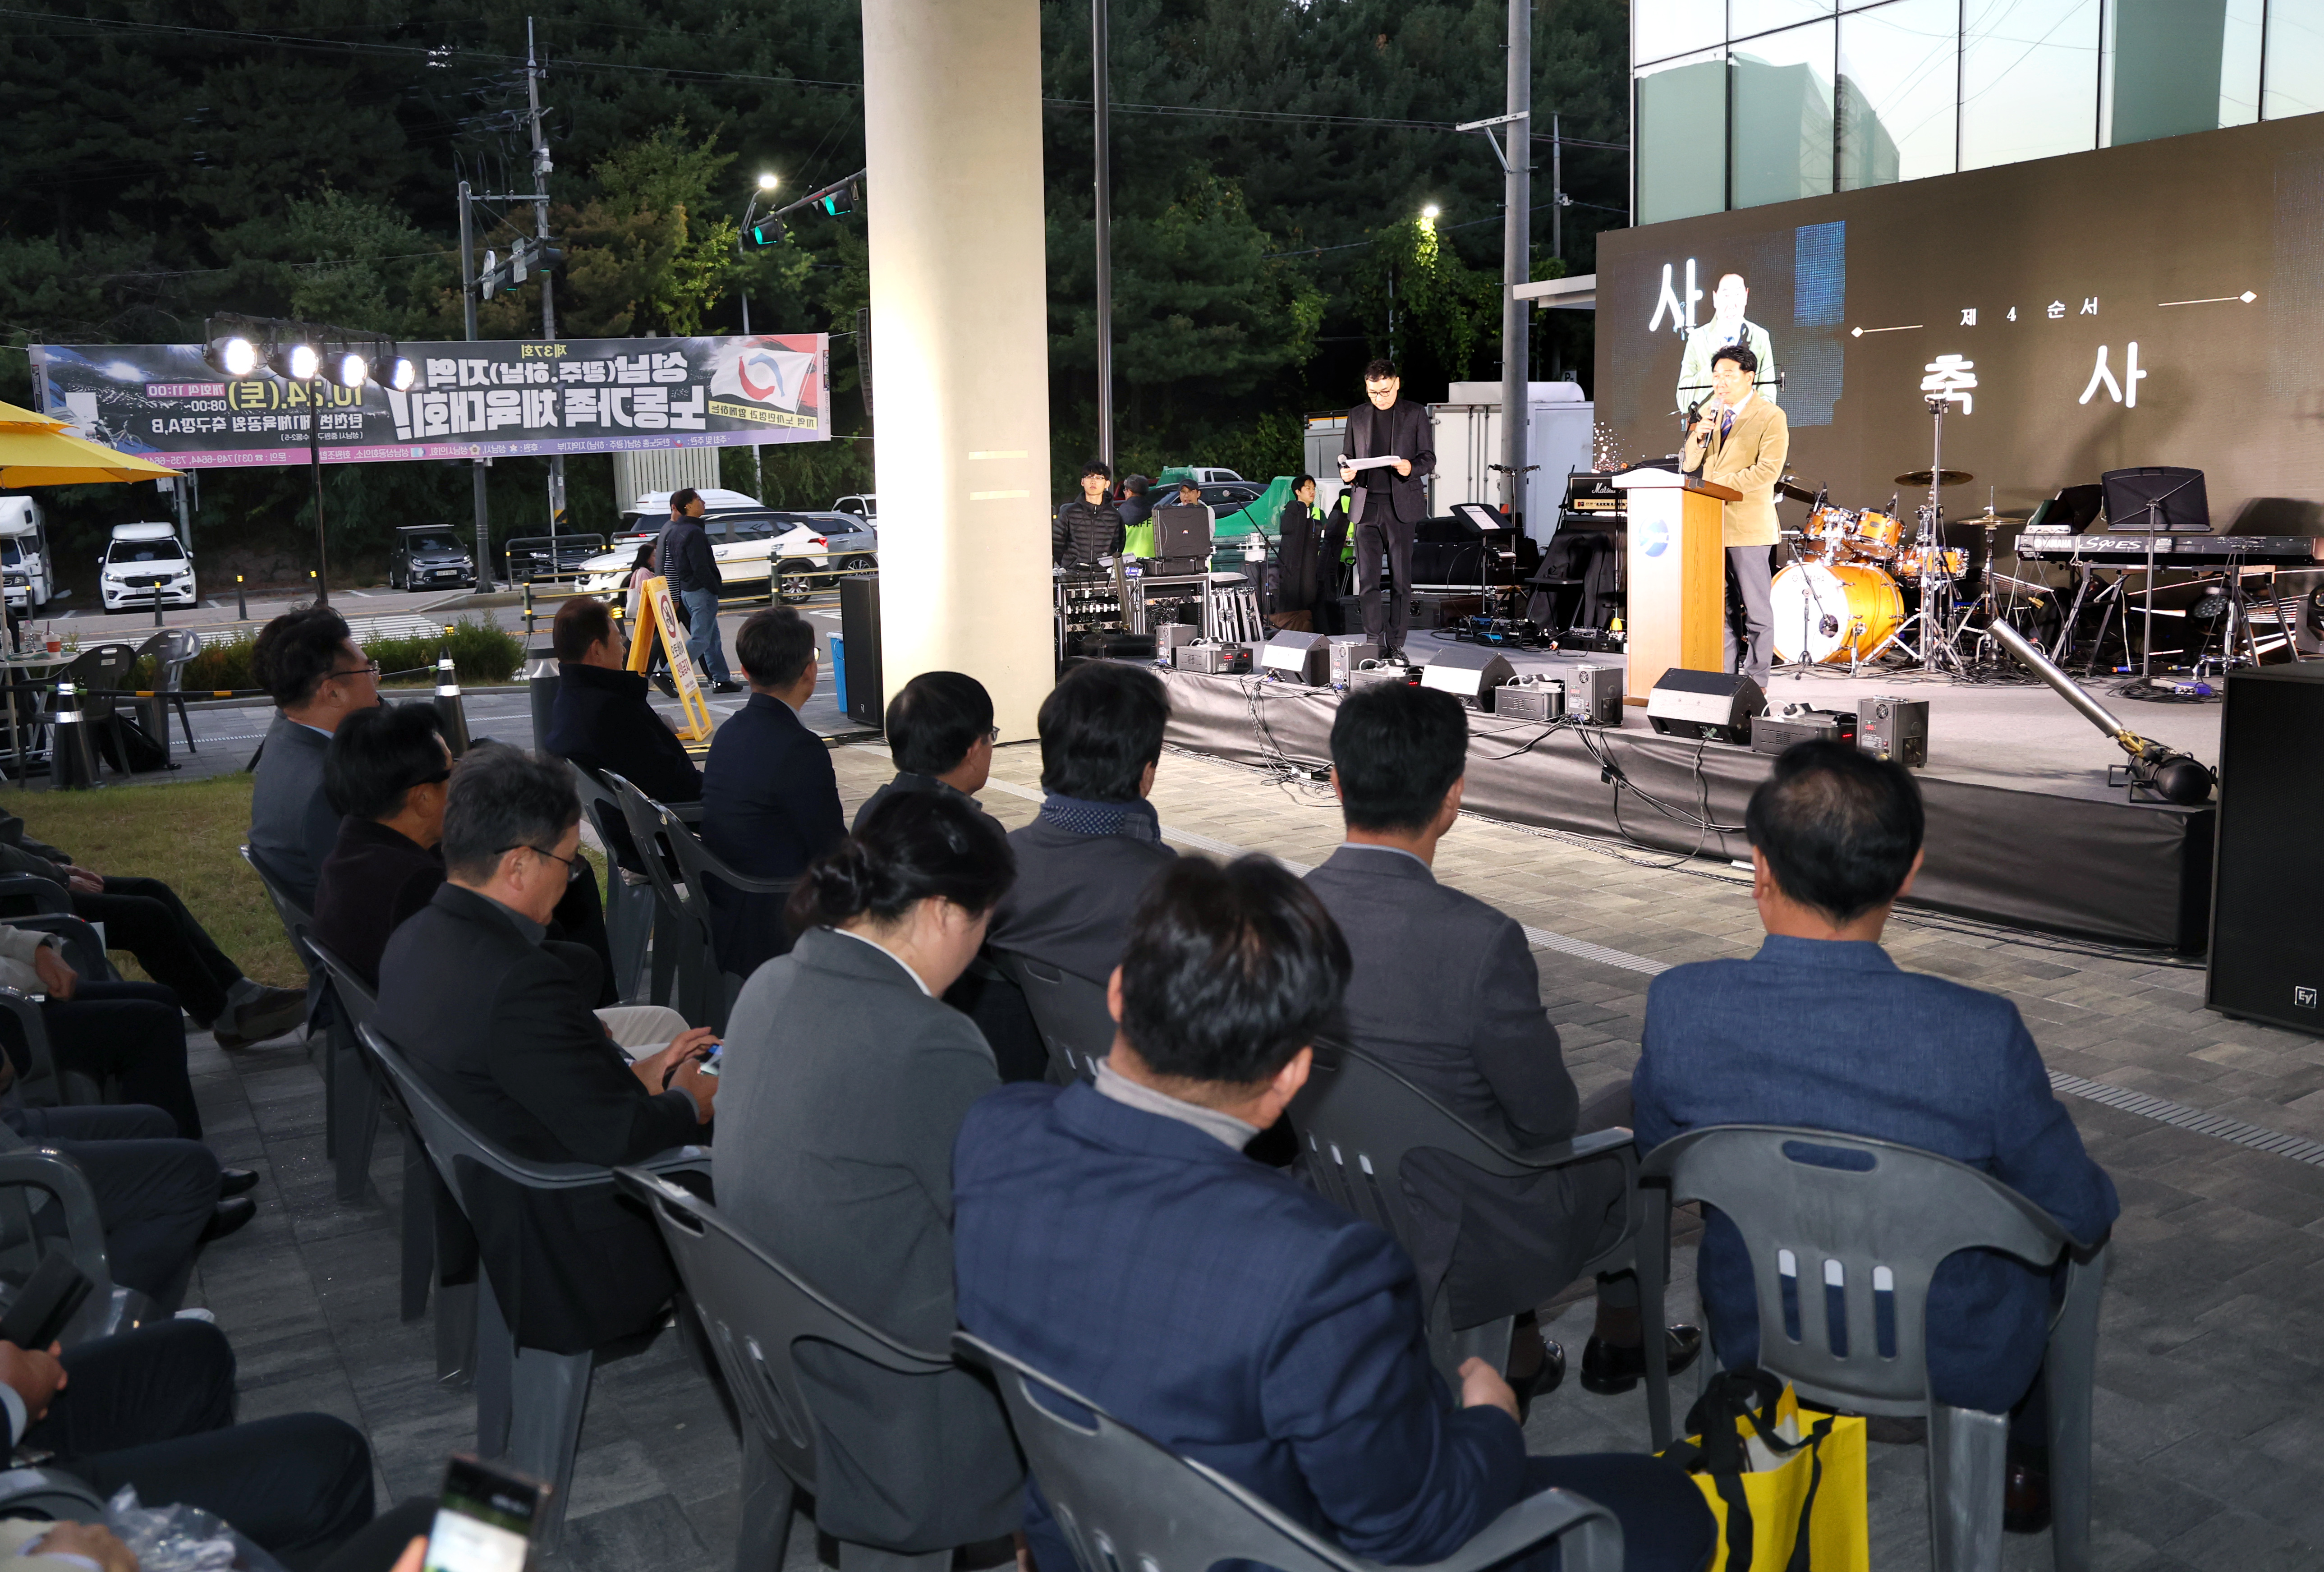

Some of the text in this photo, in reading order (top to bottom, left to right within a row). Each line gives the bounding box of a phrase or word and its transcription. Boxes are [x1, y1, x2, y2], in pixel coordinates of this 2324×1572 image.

[1649, 257, 1704, 333] 사
[1960, 308, 1977, 327] 제
[2007, 307, 2017, 322] 4
[2043, 538, 2072, 548] YAMAHA
